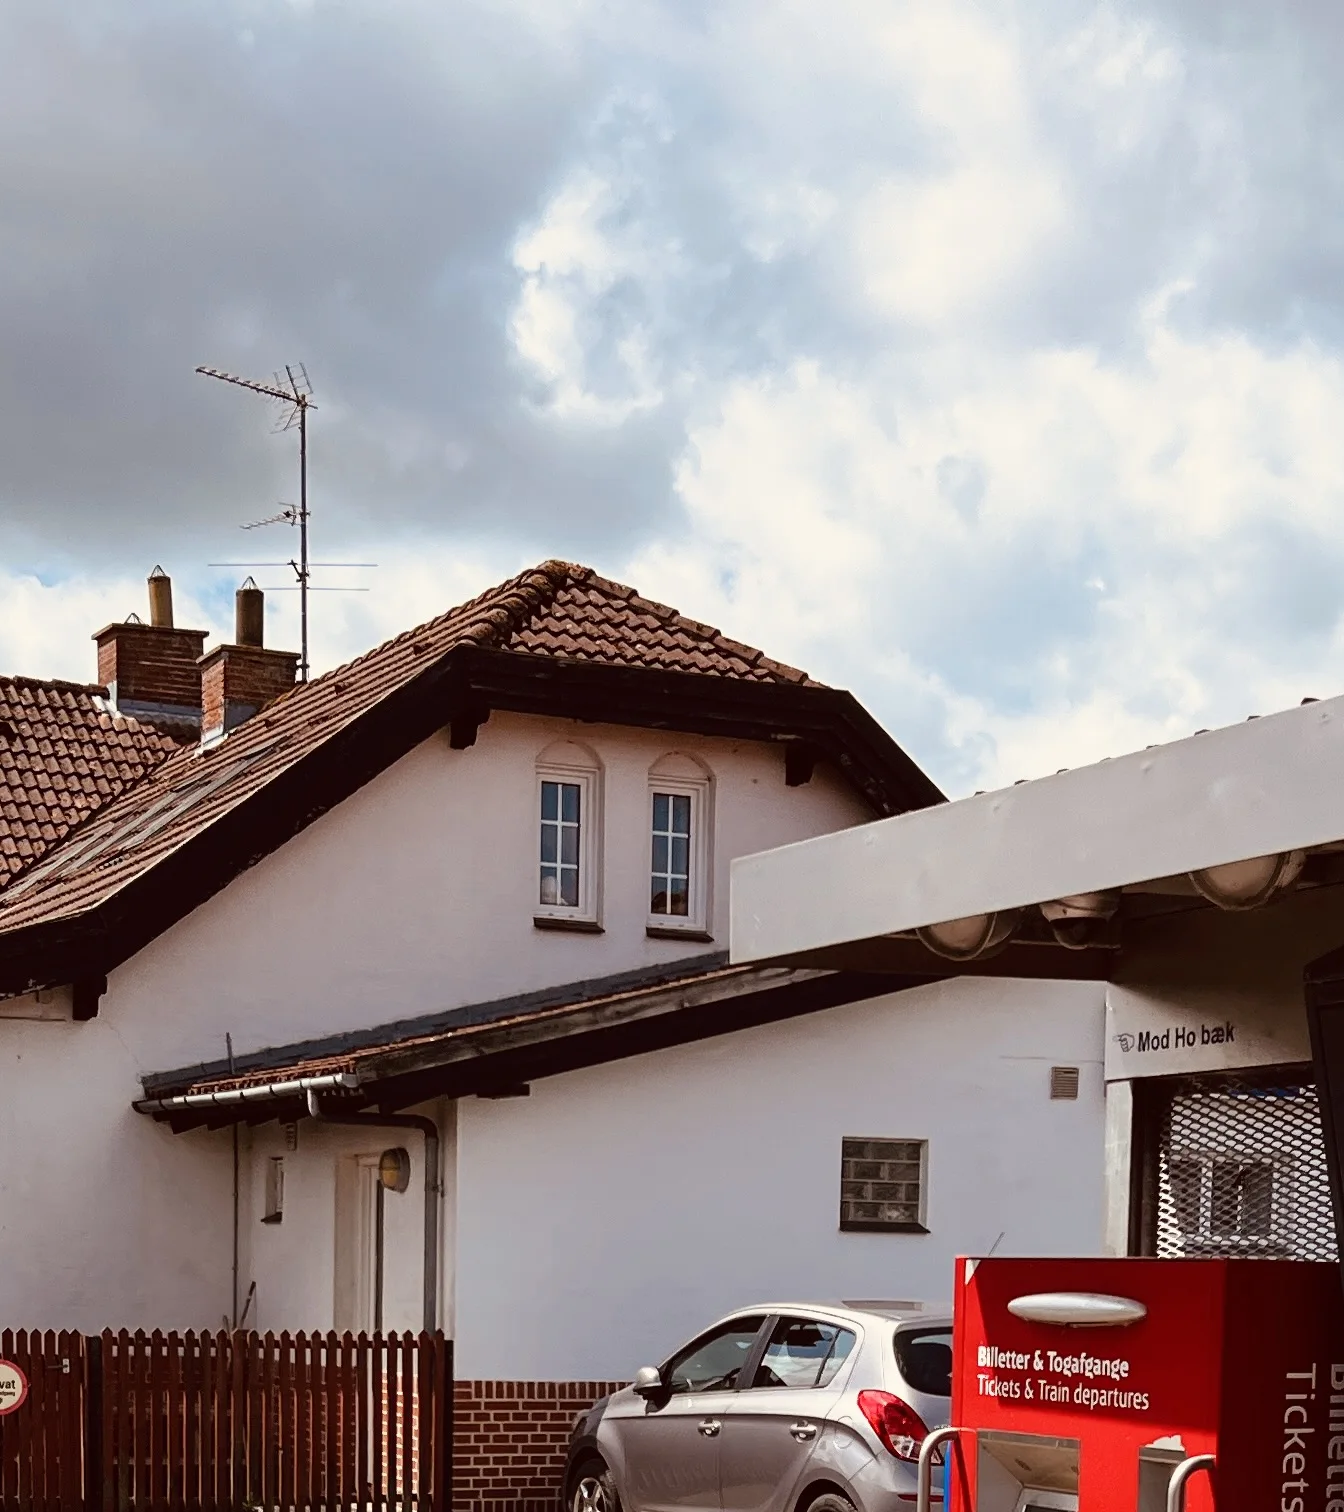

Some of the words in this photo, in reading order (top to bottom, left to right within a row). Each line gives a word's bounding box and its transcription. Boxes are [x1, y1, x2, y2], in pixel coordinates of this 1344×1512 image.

[1138, 1028, 1170, 1052] Mod
[977, 1345, 1030, 1371] Billetter
[1033, 1350, 1044, 1371] &
[977, 1374, 1020, 1399] Tickets
[1024, 1378, 1034, 1399] &
[1038, 1379, 1070, 1403] Train
[1074, 1383, 1149, 1410] departures
